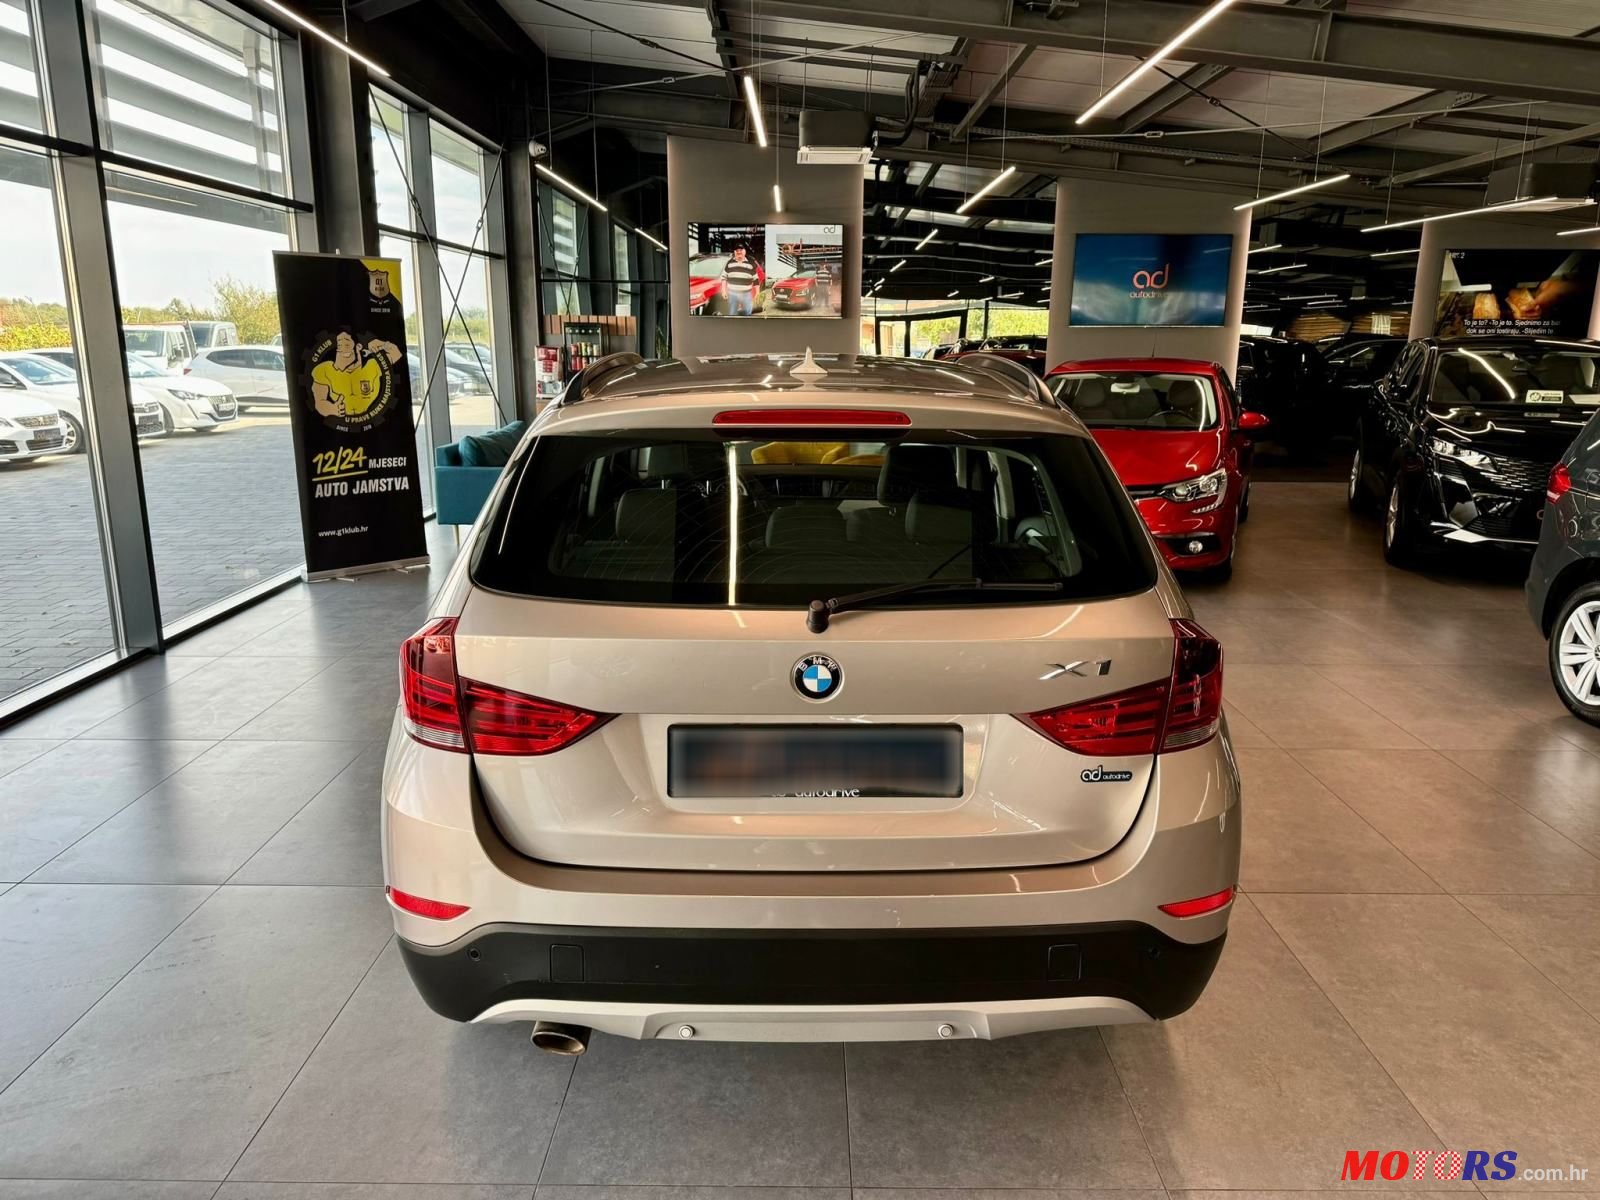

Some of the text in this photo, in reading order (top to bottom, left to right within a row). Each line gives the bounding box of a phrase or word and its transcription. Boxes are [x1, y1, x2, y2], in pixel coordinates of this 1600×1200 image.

[1132, 263, 1170, 289] ad
[1514, 319, 1542, 327] Sjednimo
[311, 339, 333, 363] G1 KLUB
[351, 414, 370, 424] PRAVE
[369, 405, 382, 418] RUKE
[380, 370, 392, 405] MAJSTORA
[312, 446, 408, 475] 12/24 MJESECI
[314, 476, 410, 498] AUTO JAMSTVA
[318, 525, 369, 537] www.g1klub.hr
[799, 655, 838, 672] BMW
[1039, 659, 1112, 680] X1
